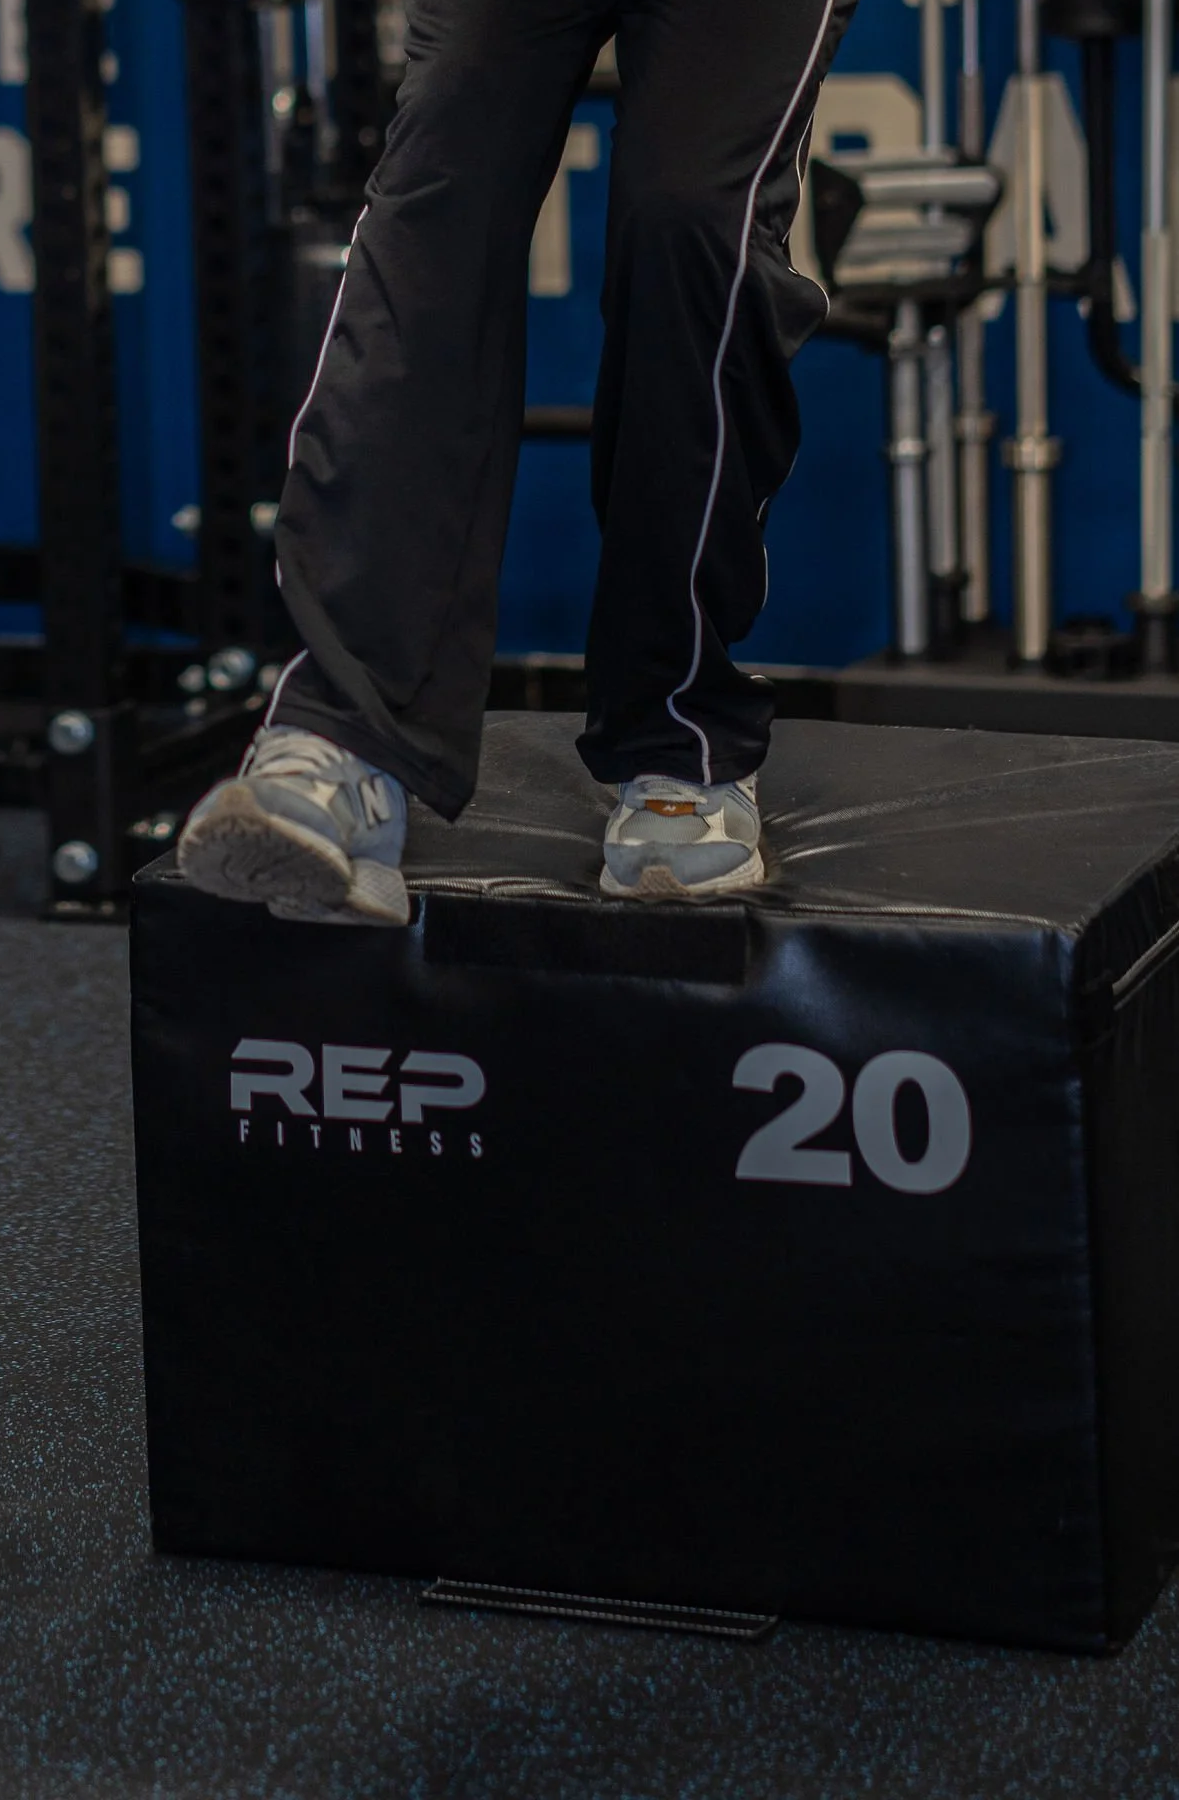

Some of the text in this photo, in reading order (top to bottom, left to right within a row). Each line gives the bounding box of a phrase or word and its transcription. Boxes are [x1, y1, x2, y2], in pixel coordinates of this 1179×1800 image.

[229, 1037, 487, 1124] REP
[731, 1041, 973, 1195] 20
[238, 1117, 485, 1160] FITNESS
